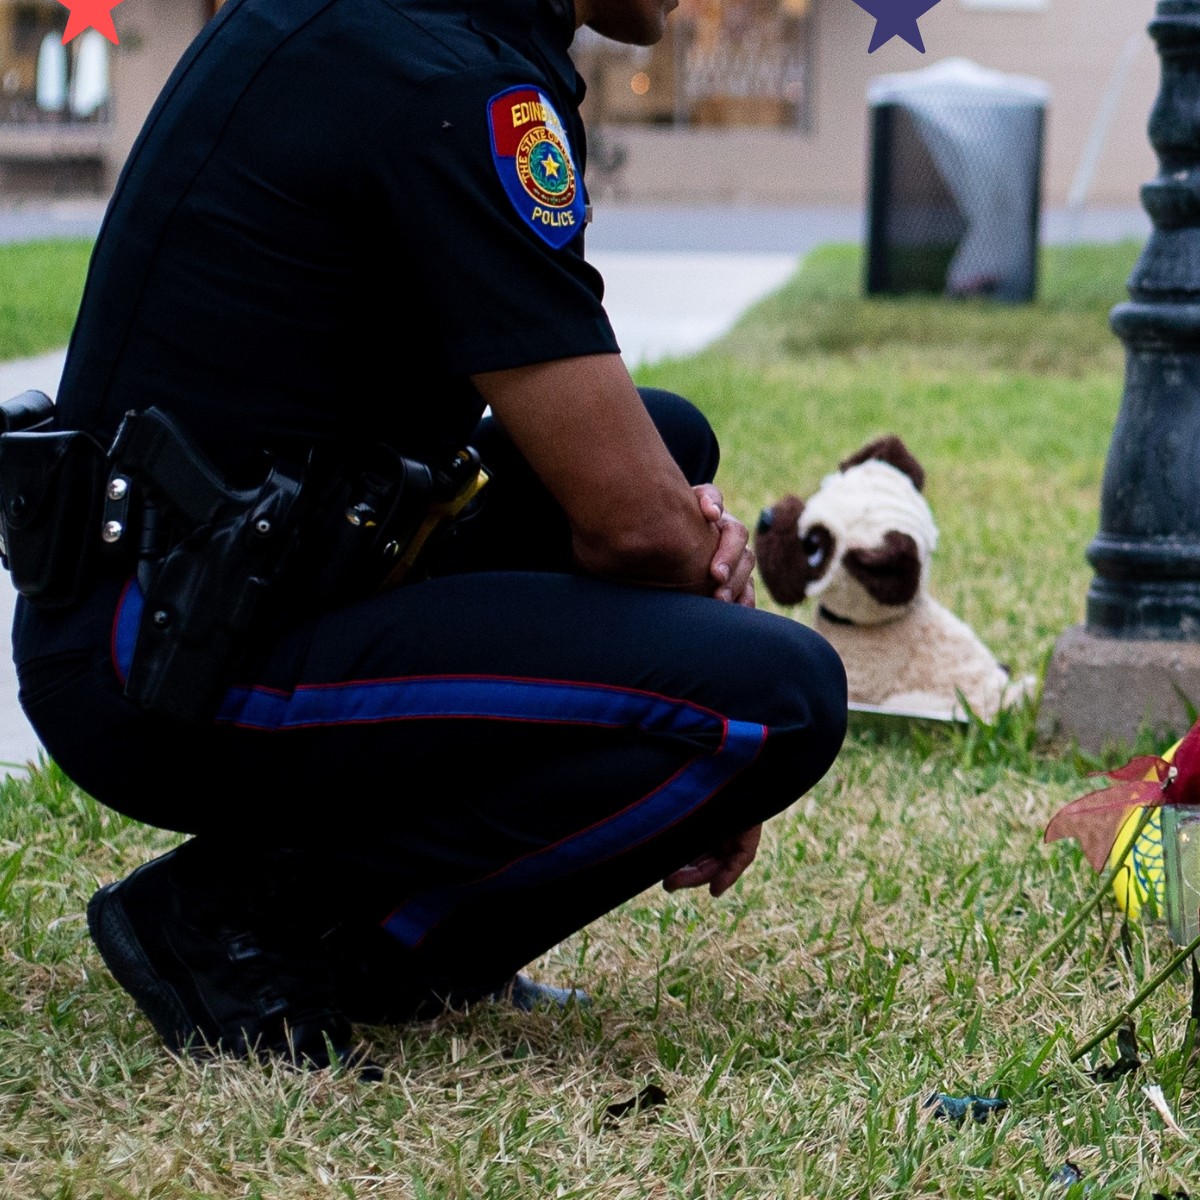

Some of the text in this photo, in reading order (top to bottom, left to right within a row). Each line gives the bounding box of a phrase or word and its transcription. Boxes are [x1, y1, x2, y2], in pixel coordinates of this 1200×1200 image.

[521, 129, 546, 153] STATE
[548, 132, 559, 144] OF
[519, 156, 530, 184] THE
[532, 206, 575, 227] POLICE
